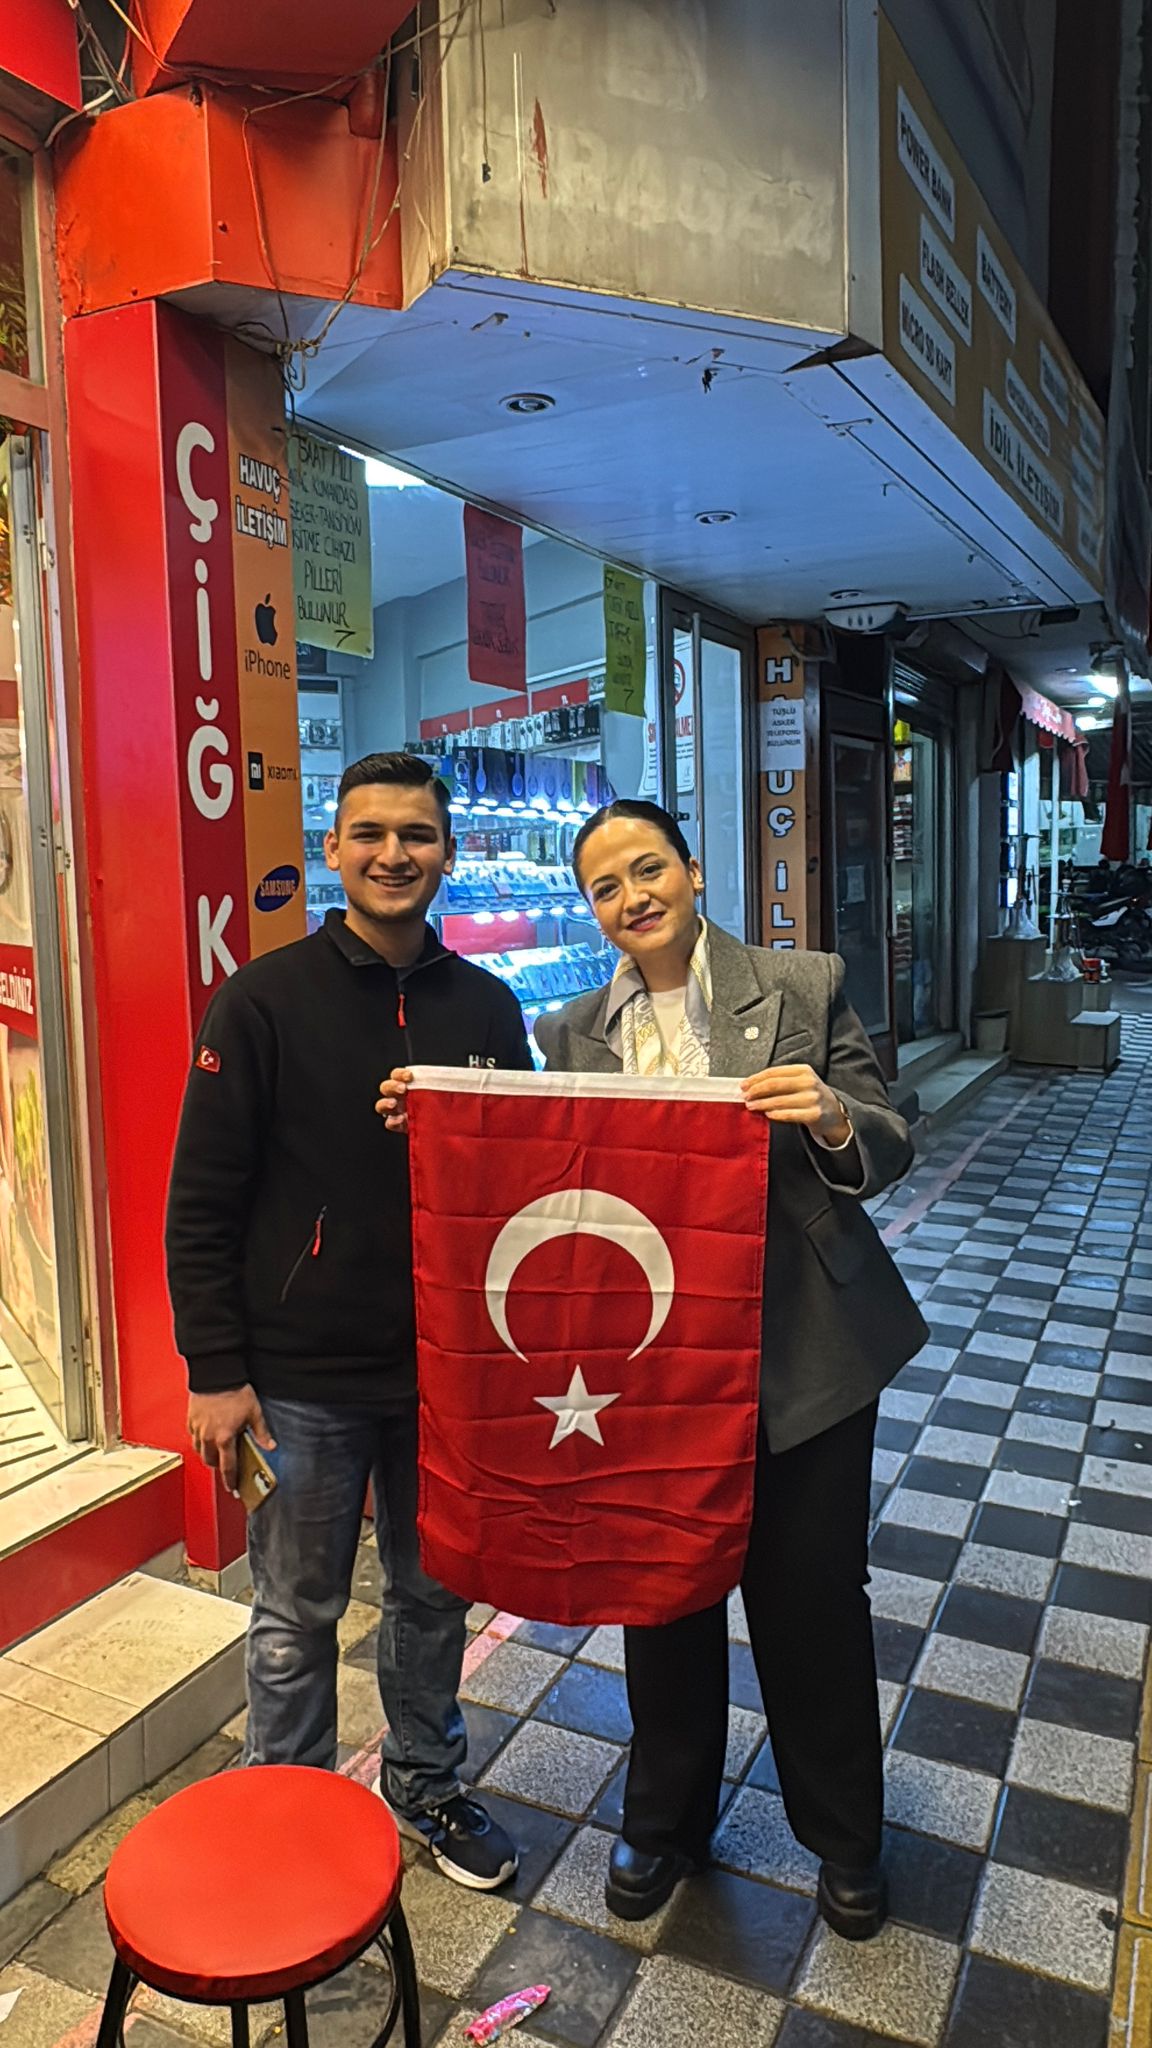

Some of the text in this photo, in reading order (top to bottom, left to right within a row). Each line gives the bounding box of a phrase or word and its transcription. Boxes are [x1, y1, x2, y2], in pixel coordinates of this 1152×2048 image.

[900, 111, 953, 222] POWER BANK
[922, 240, 970, 330] FLASH BELLEK
[935, 347, 952, 386] KART
[299, 438, 328, 472] SAAT
[990, 407, 1014, 472] İDİL
[239, 453, 282, 504] HAVUÇ
[235, 494, 288, 550] İLETİŞİM
[175, 421, 235, 821] ÇİĞ
[297, 594, 350, 628] BULUNUR
[244, 649, 290, 680] iPhone
[260, 879, 297, 897] SAMSUNG
